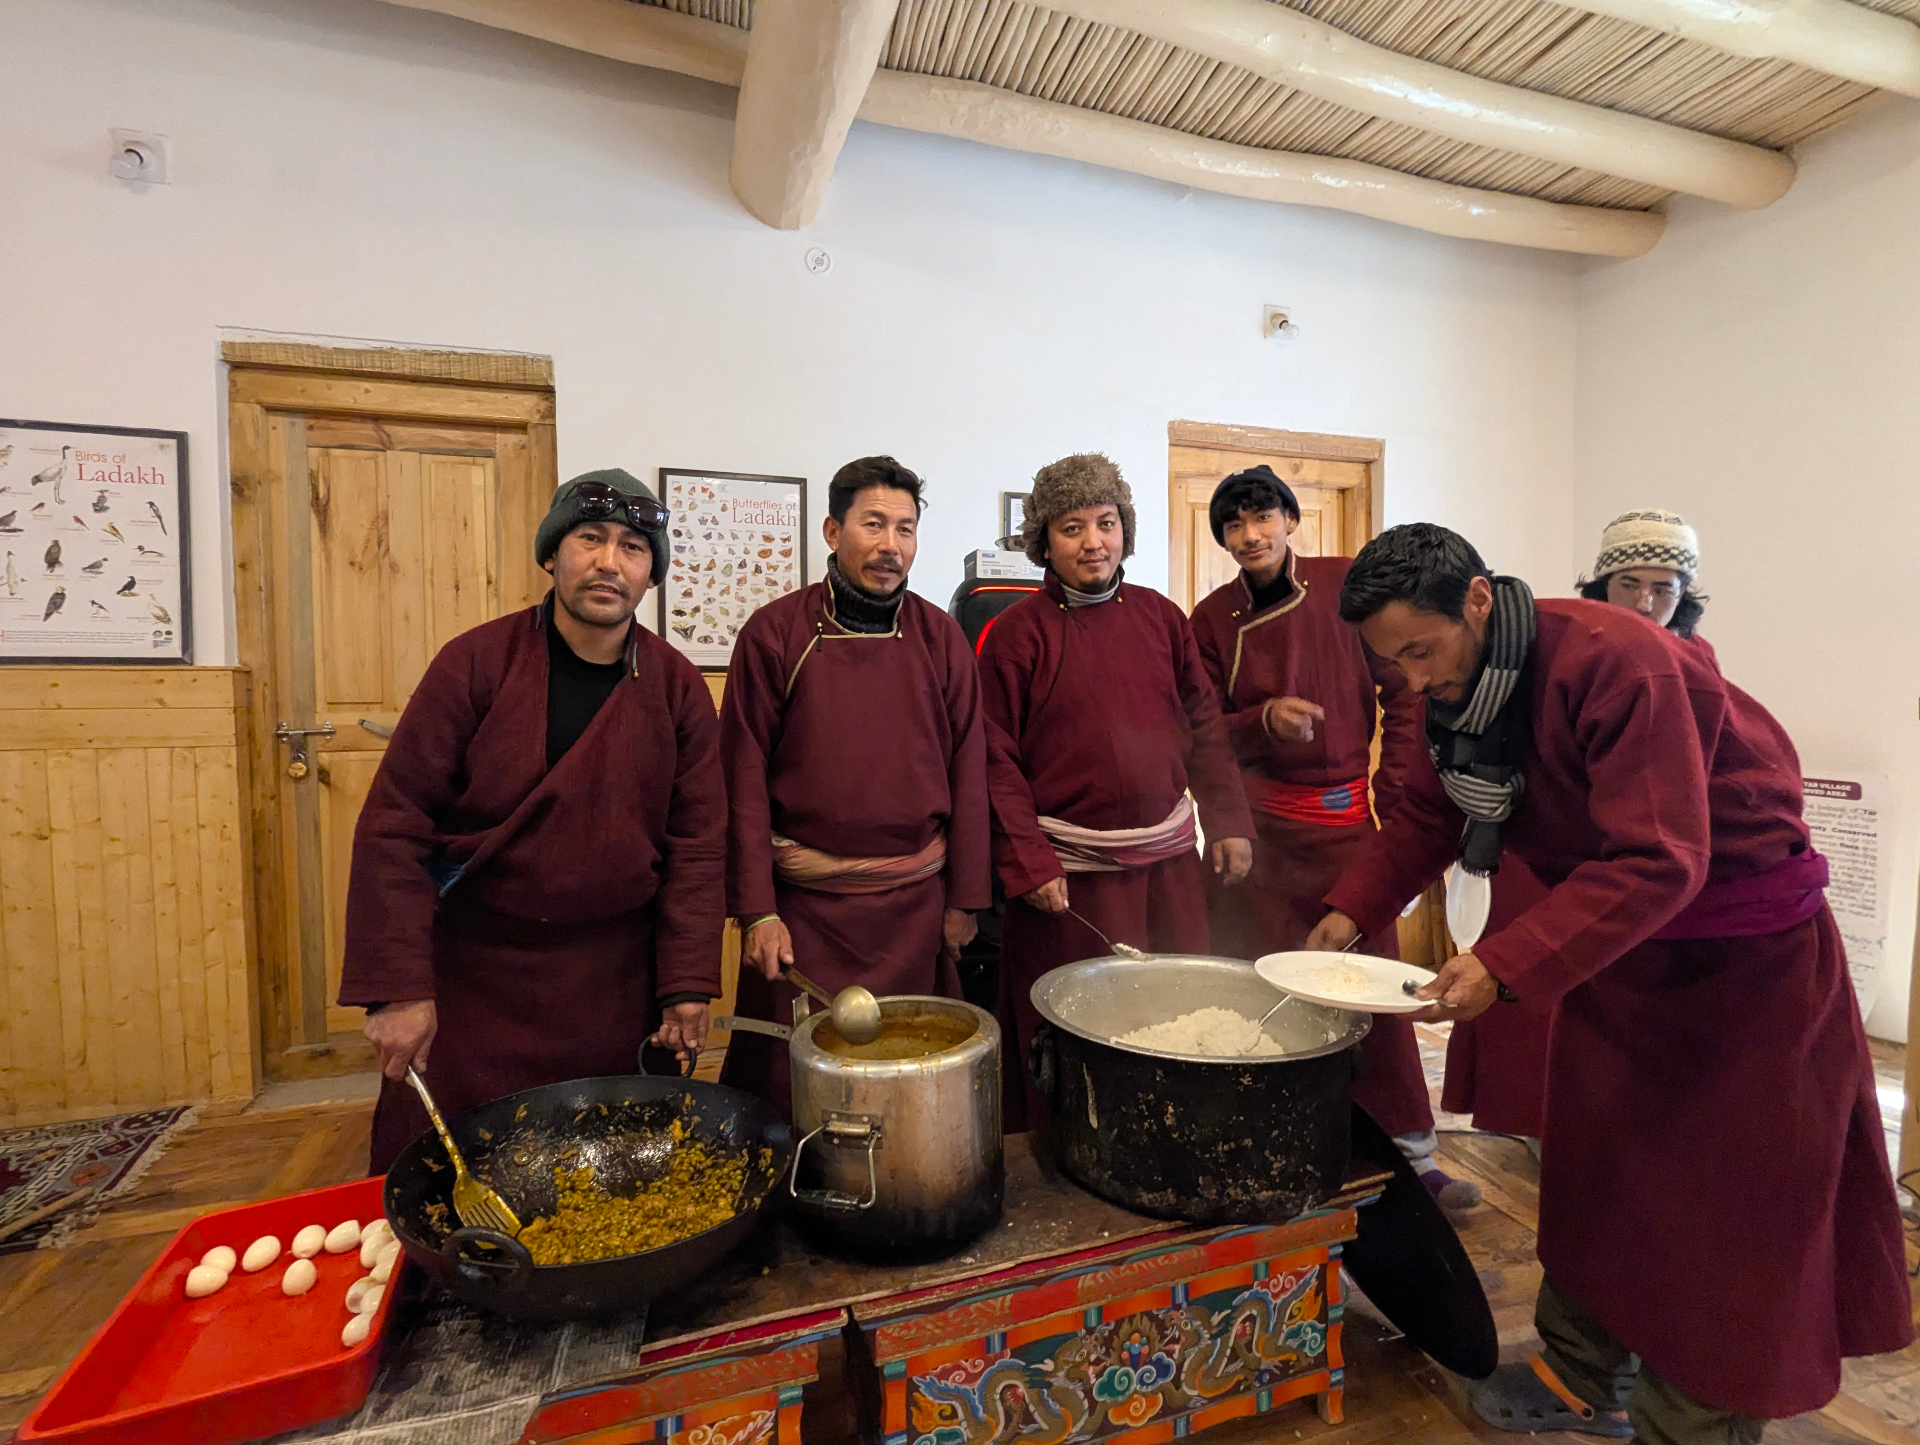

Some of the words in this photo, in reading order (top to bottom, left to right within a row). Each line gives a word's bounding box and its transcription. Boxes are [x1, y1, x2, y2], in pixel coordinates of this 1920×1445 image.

[75, 450, 108, 463] Birds
[113, 453, 127, 464] of
[76, 463, 166, 485] Ladakh
[732, 498, 782, 510] Butterflies
[786, 502, 797, 511] of
[732, 507, 797, 527] Ladakh
[1804, 781, 1818, 789] TAR
[1819, 783, 1851, 791] VILLAGE
[1826, 790, 1848, 798] AREA
[1831, 827, 1877, 838] Conserved
